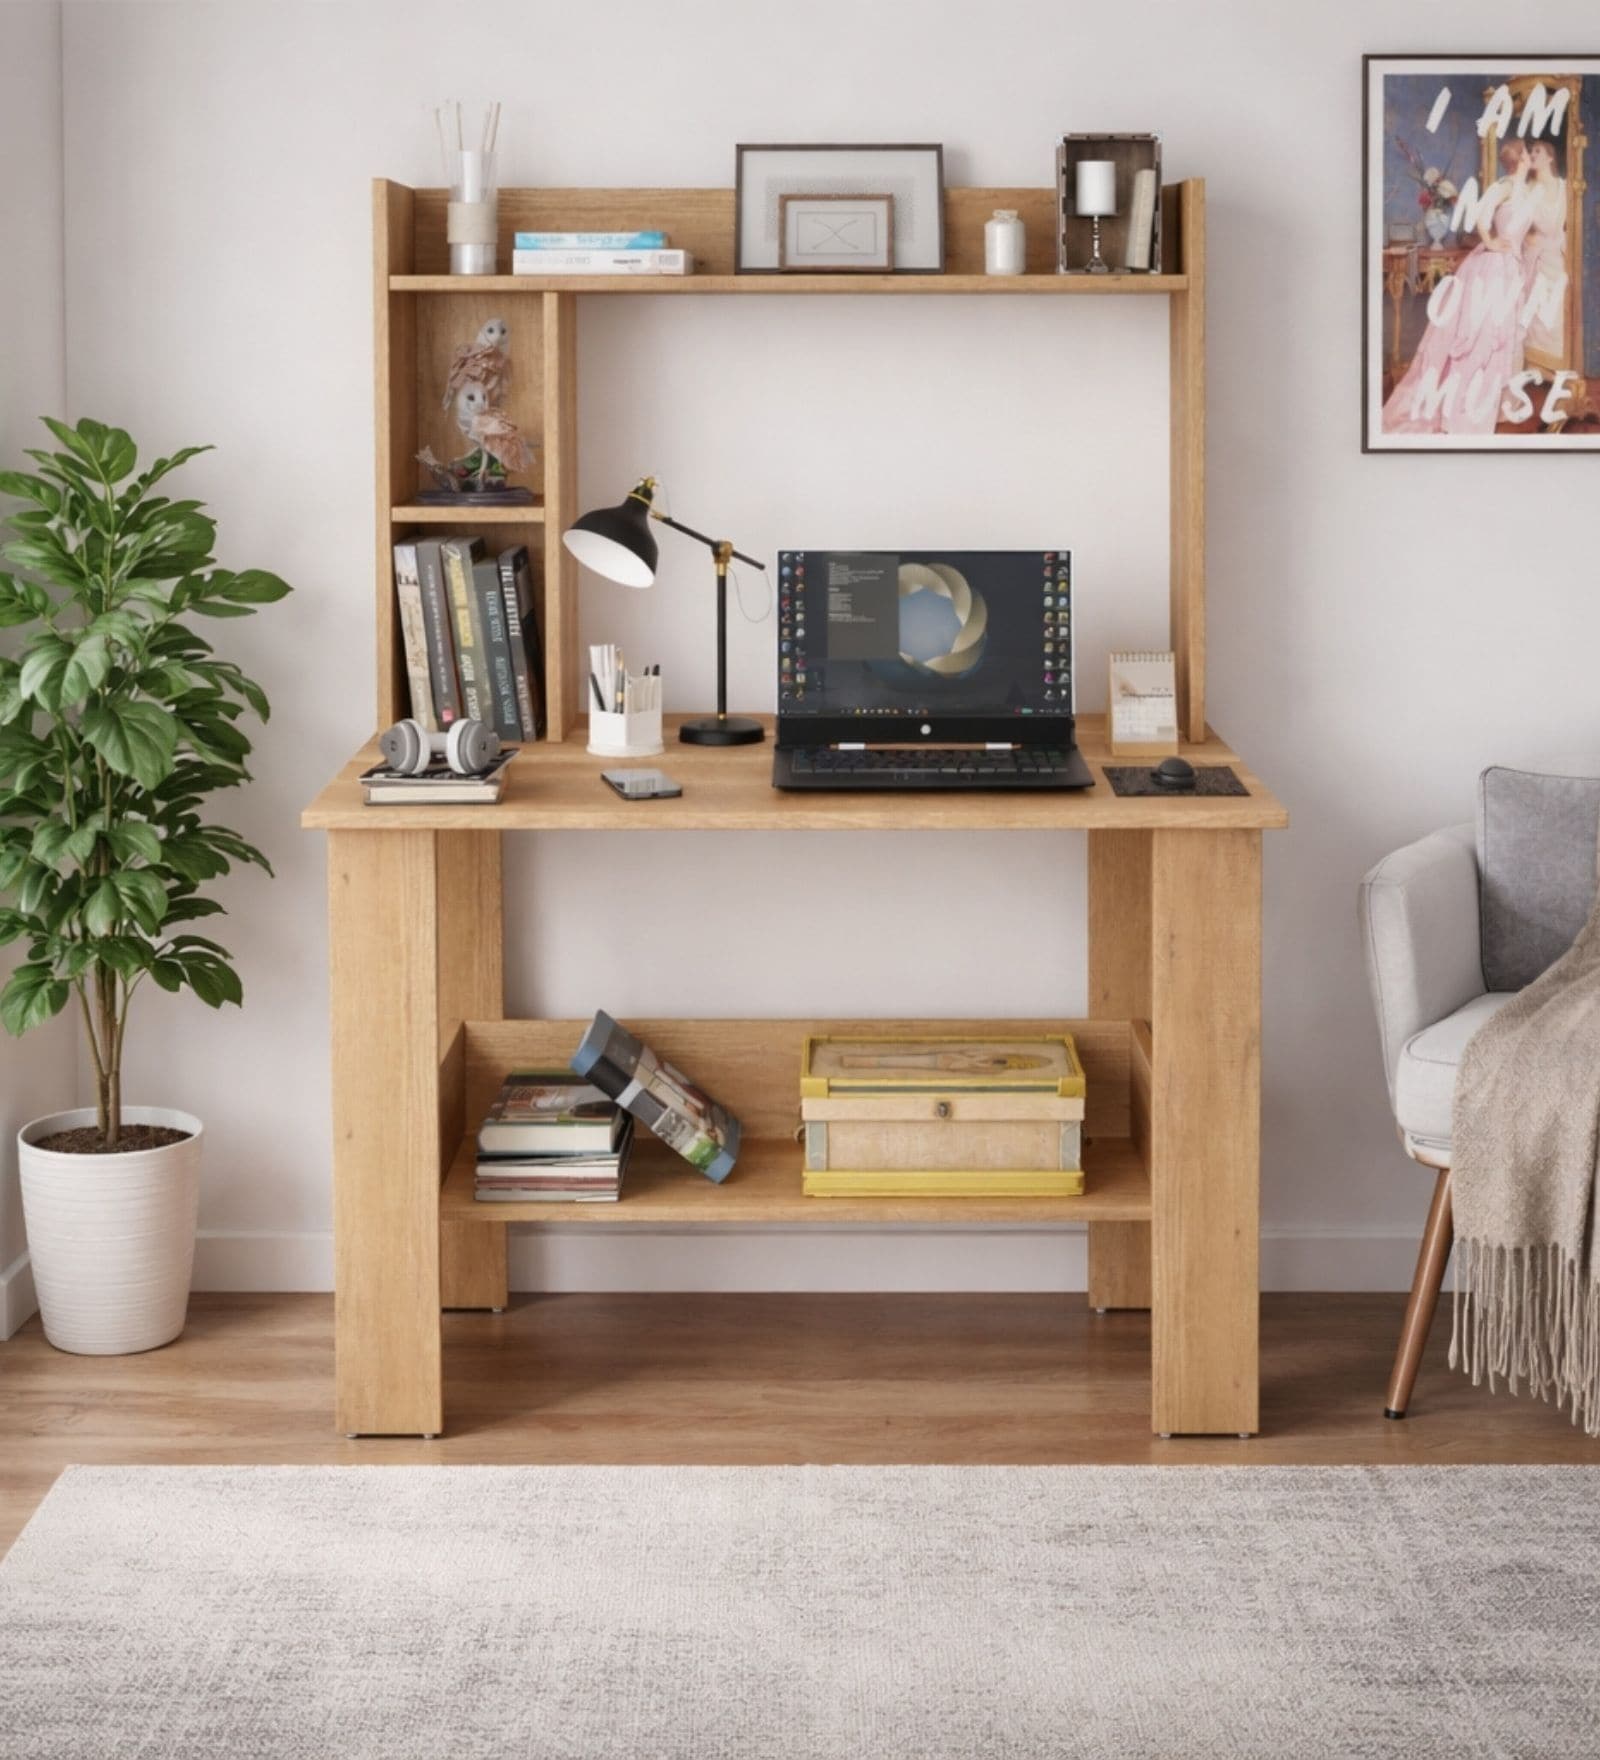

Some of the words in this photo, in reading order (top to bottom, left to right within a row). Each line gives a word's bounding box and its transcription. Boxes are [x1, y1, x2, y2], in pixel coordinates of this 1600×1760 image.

[1426, 87, 1452, 134] I
[1477, 83, 1570, 138] AM
[1427, 273, 1569, 329] OWN
[1411, 367, 1578, 424] MUSE
